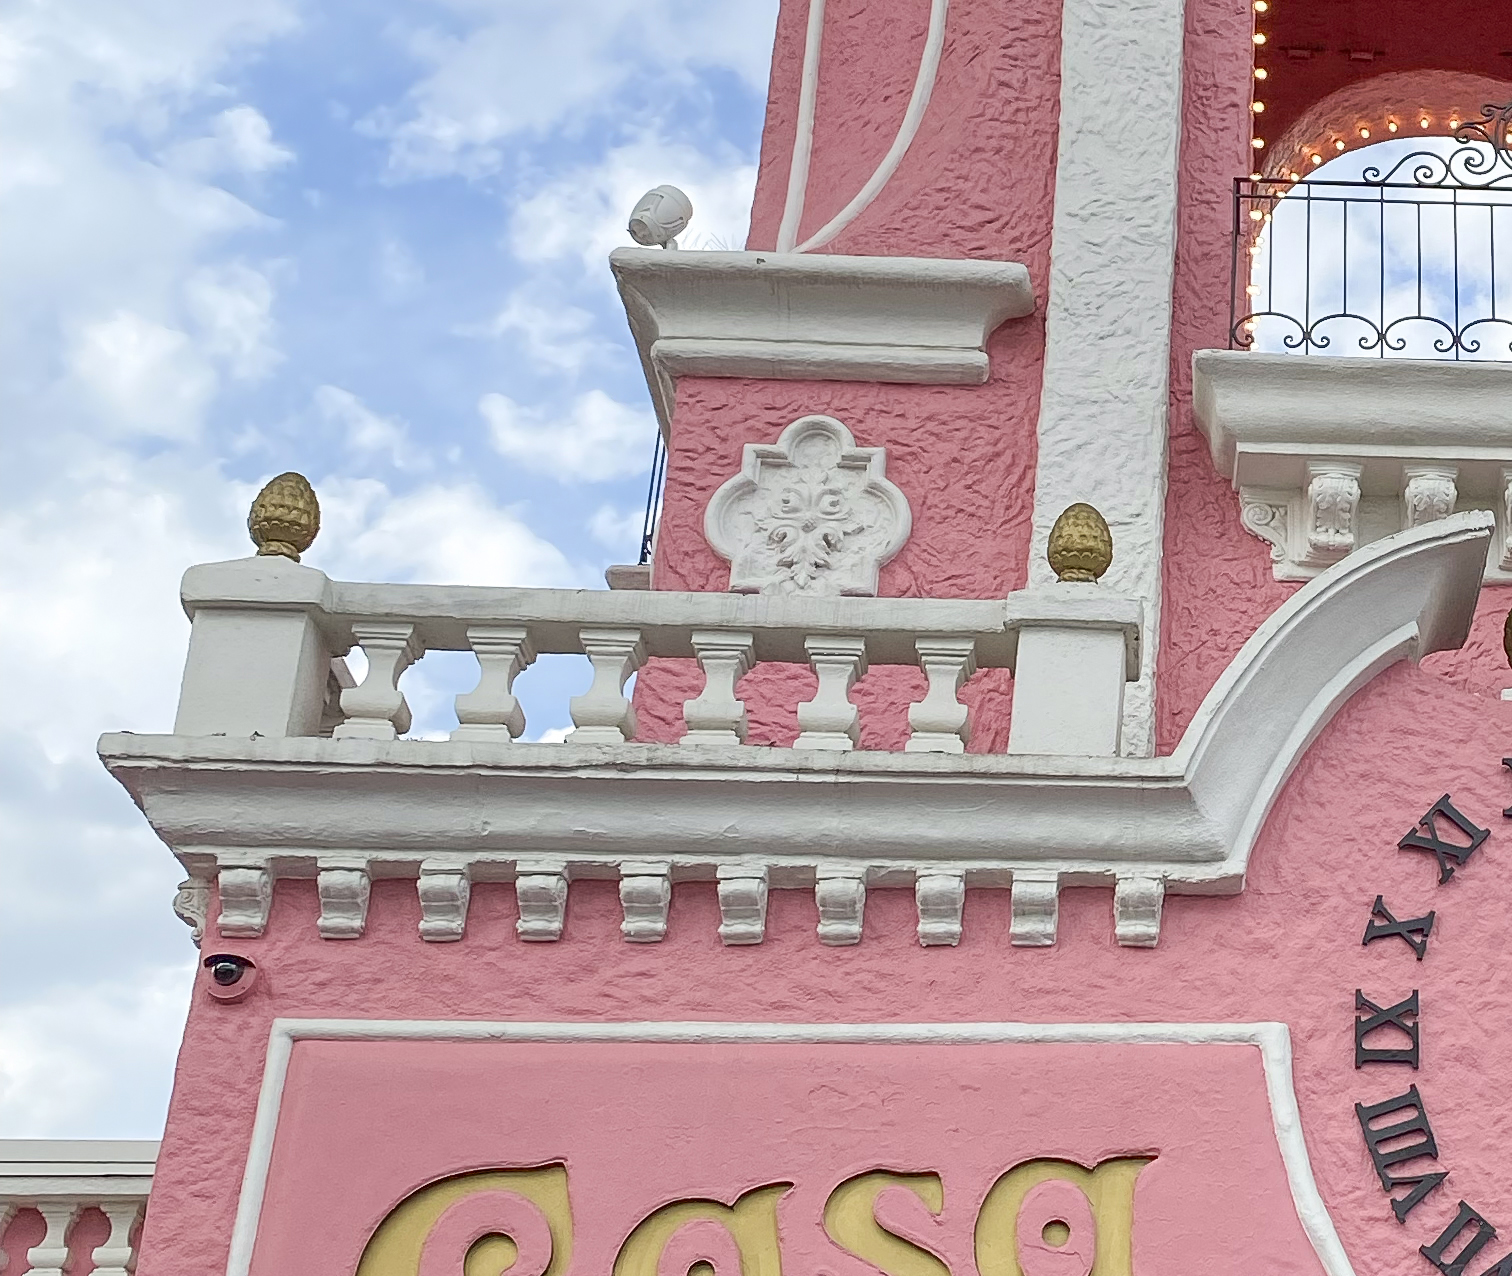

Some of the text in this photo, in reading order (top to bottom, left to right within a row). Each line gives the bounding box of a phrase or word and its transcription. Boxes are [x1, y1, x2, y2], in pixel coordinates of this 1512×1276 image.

[1397, 794, 1491, 884] XI
[1362, 895, 1436, 961] X
[1354, 989, 1419, 1069] IX
[1354, 1084, 1450, 1223] VIII
